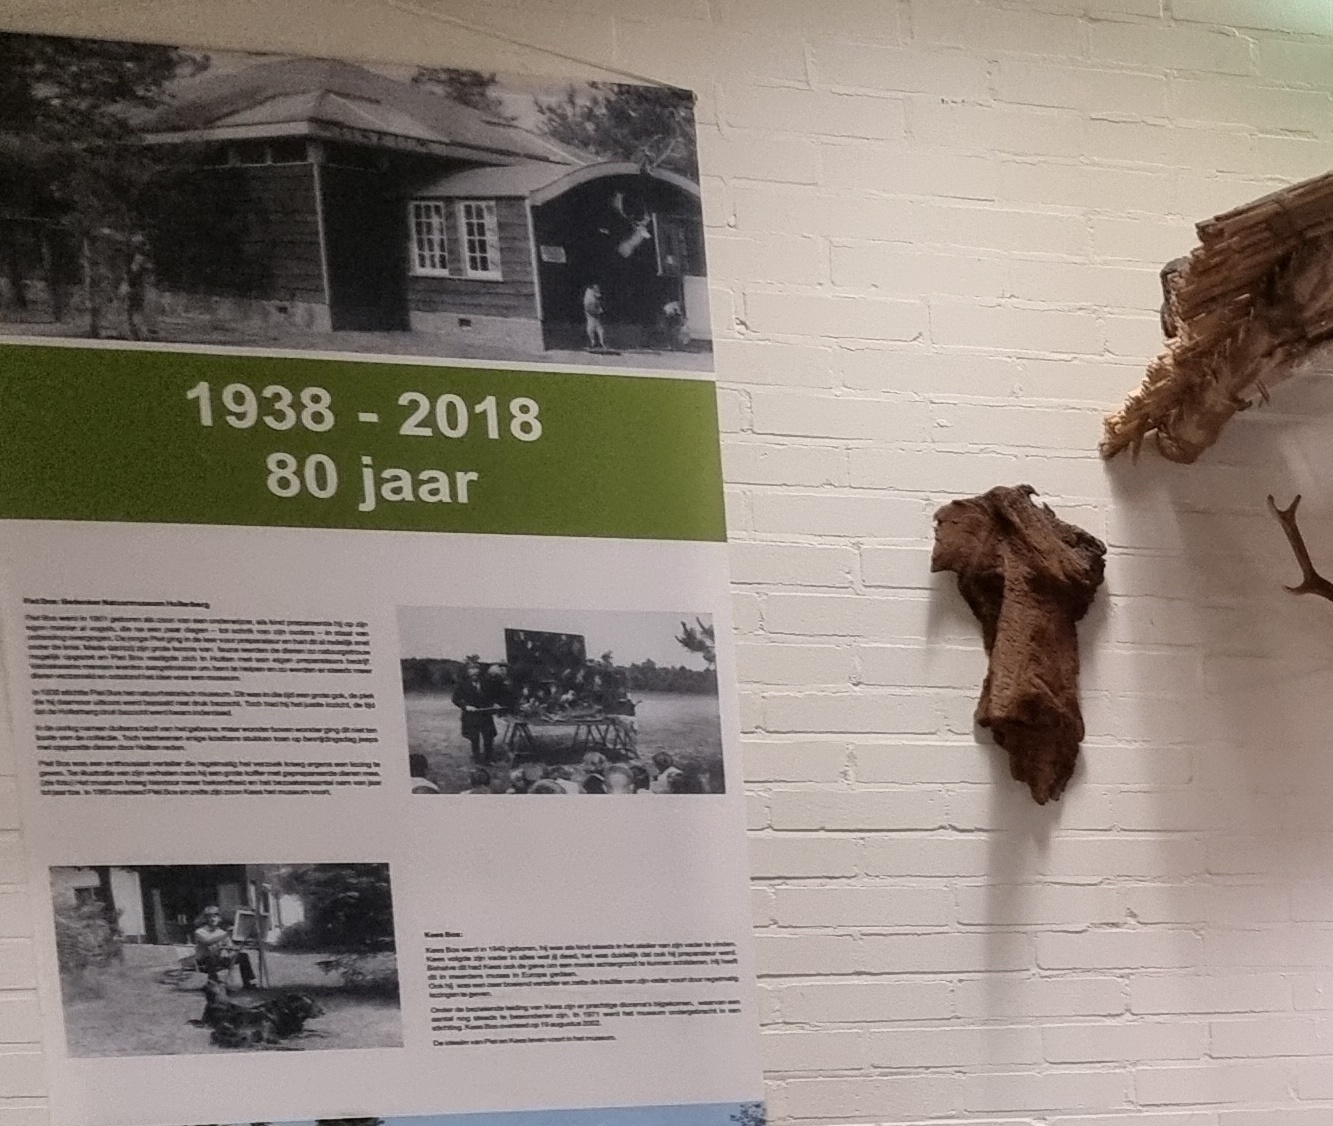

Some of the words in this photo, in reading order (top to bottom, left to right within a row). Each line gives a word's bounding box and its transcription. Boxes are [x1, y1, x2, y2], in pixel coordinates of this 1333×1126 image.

[187, 382, 334, 431] 1938
[359, 413, 378, 422] -
[398, 392, 542, 441] 2018
[266, 453, 337, 498] 80
[359, 456, 478, 510] jaar
